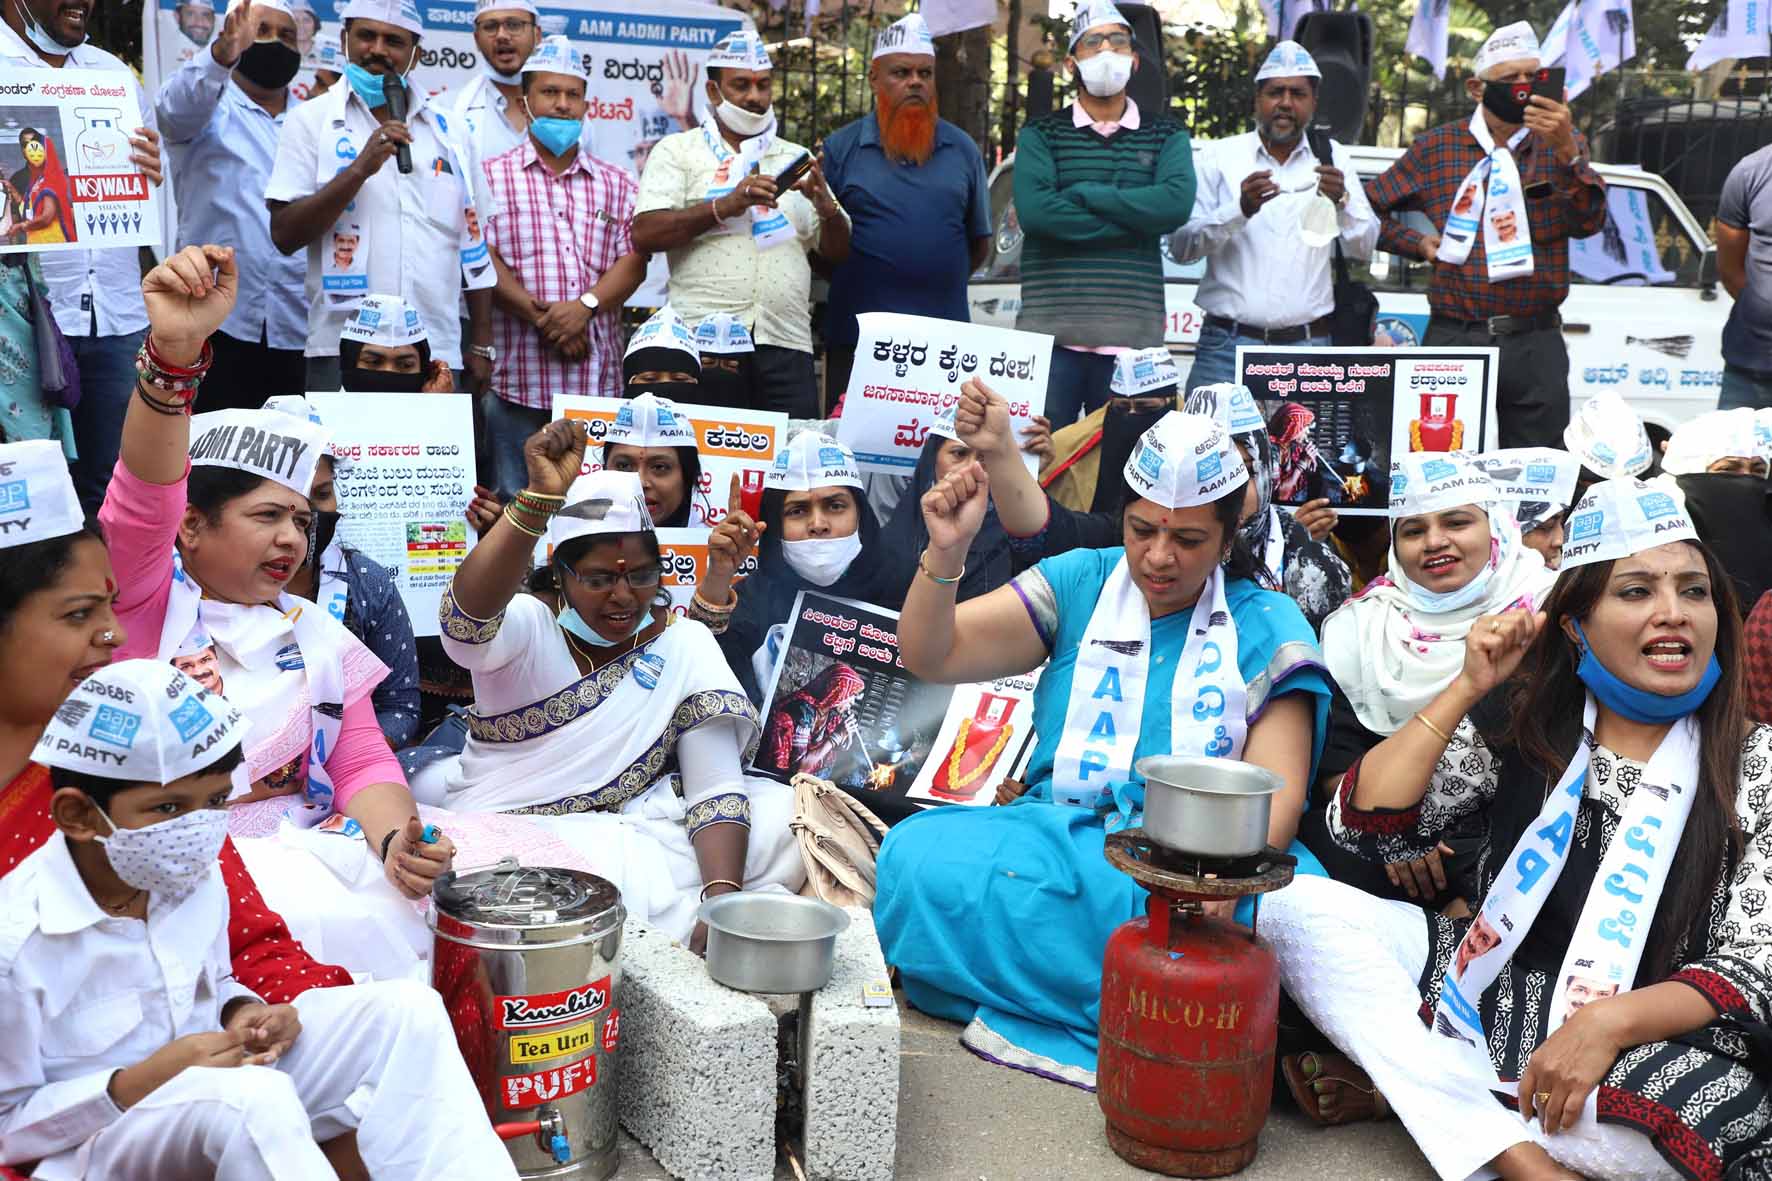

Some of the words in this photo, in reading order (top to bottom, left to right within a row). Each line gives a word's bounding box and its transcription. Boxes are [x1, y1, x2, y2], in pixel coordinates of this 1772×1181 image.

[579, 20, 613, 37] AAM
[617, 23, 666, 39] AADMI
[670, 27, 717, 43] PARTY
[873, 336, 928, 377] ಕಳ್ಳರ
[939, 345, 978, 382] ಕೈಲಿ
[989, 351, 1036, 381] ದೇಶ!
[426, 445, 459, 456] ರಾಬರಿ
[706, 426, 768, 450] ಕಮಲ
[189, 425, 238, 461] ADMI
[233, 426, 308, 480] PARTY
[1128, 463, 1154, 490] PARTY
[1198, 475, 1227, 495] AAM
[1430, 479, 1465, 493] AAM
[1506, 487, 1549, 495] PARTY
[1655, 519, 1688, 534] AAM
[1563, 542, 1601, 560] PARTY
[100, 706, 136, 738] aap
[1079, 666, 1123, 780] AAP
[56, 739, 127, 766] PARTY
[191, 722, 228, 759] AAM
[504, 989, 605, 1025] Kwality
[518, 1041, 550, 1057] Tea
[557, 1032, 589, 1051] Urn
[507, 1059, 593, 1105] PUF!
